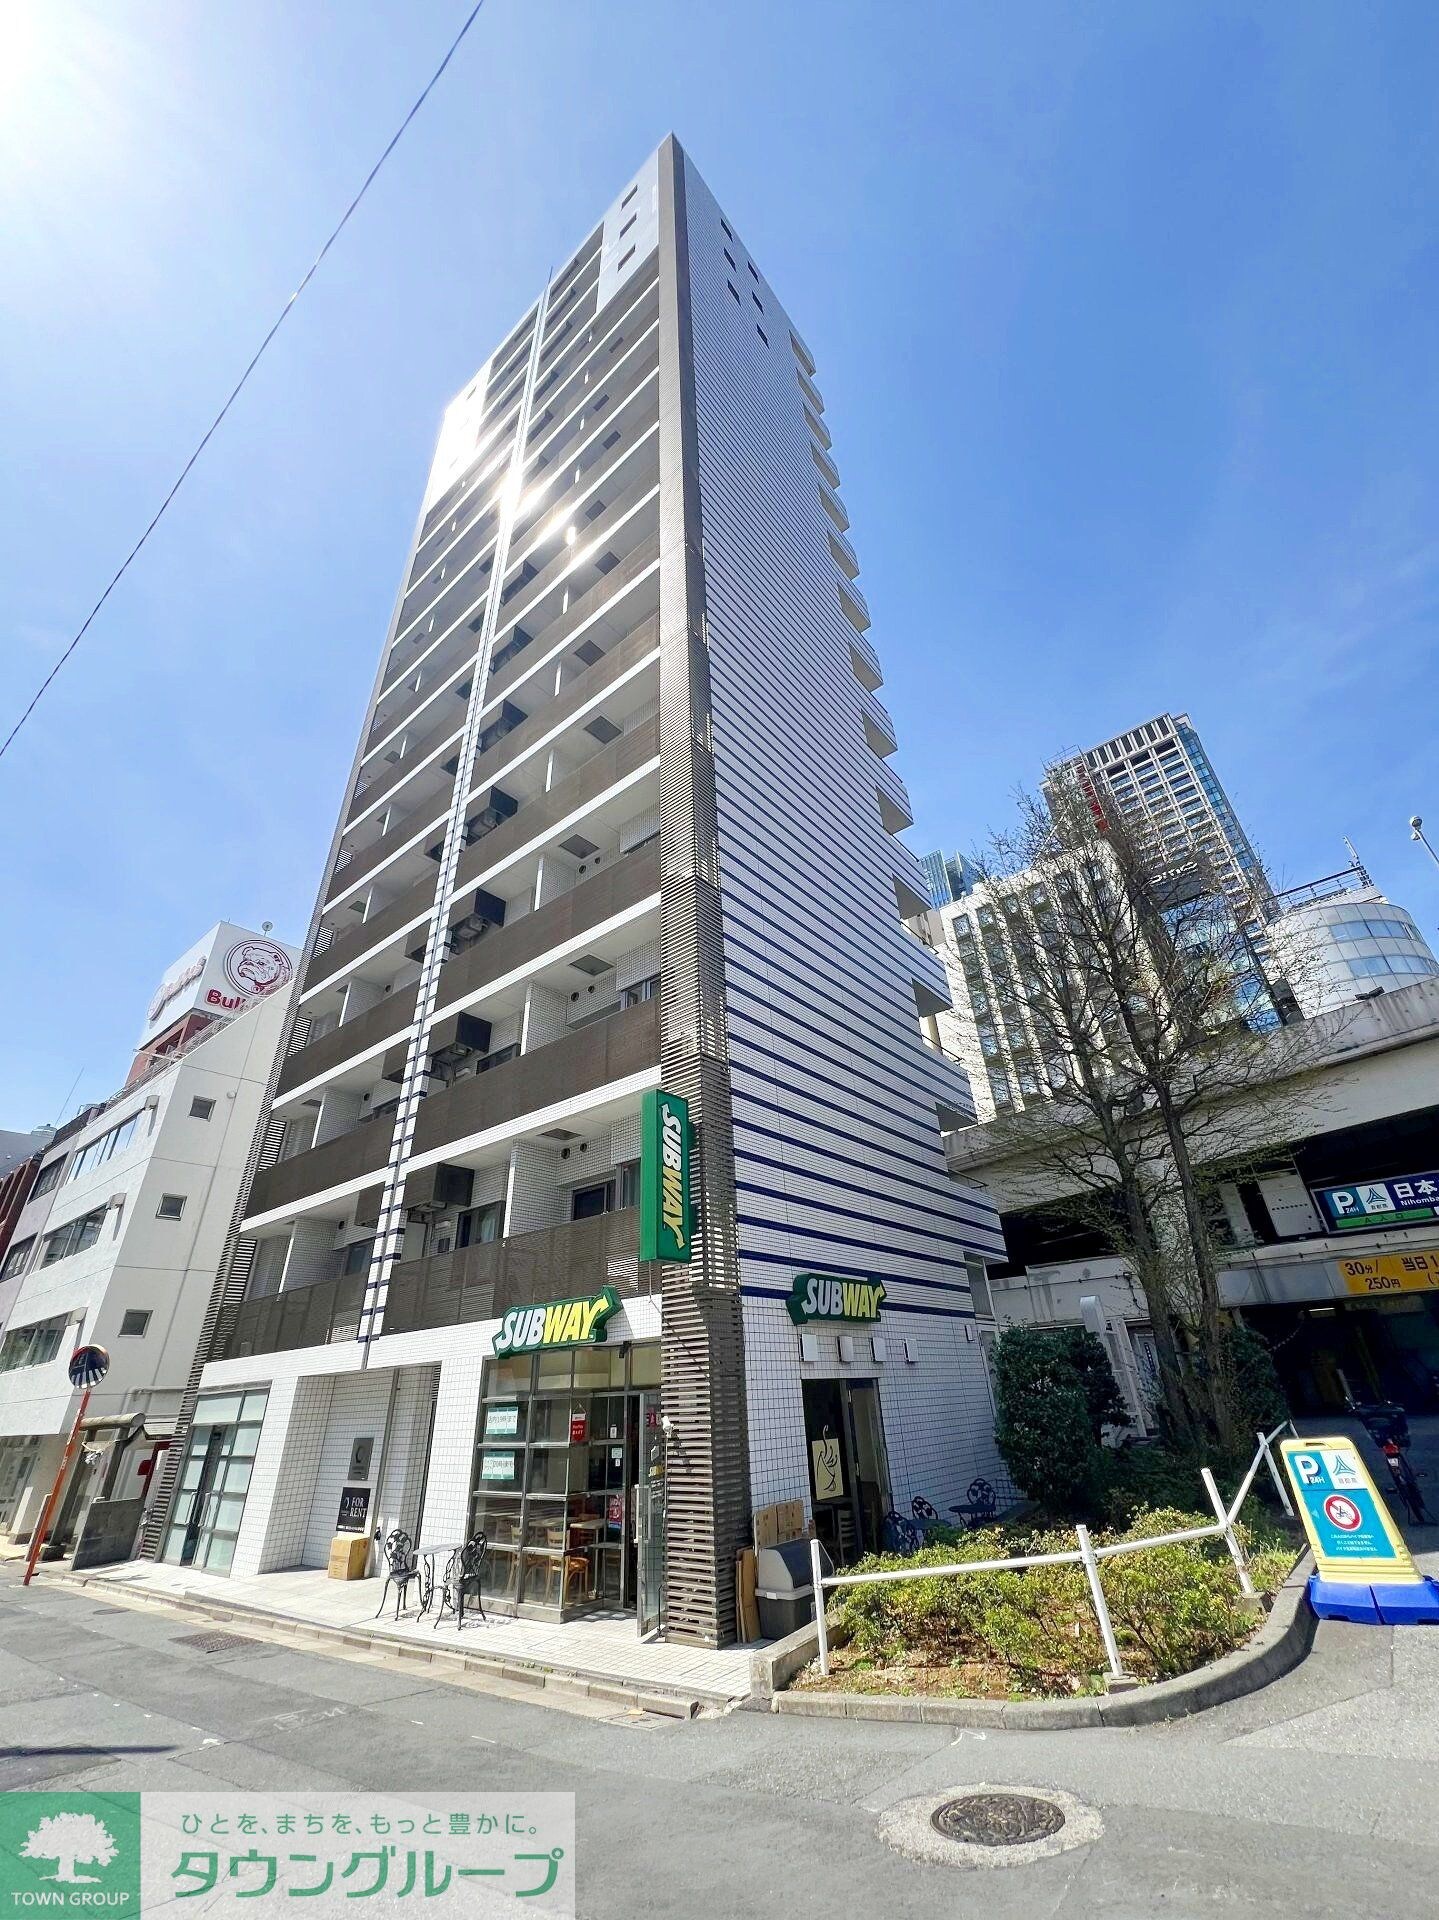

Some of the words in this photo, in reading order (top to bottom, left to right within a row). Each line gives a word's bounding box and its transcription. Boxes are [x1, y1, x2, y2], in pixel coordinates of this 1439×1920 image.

[660, 1103, 686, 1249] SUBWAY
[1331, 1191, 1355, 1215] P
[1345, 1206, 1360, 1214] 24H
[1364, 1276, 1401, 1290] 250円
[801, 1278, 885, 1318] SUBWAY
[495, 1295, 610, 1350] SUBWAY
[1294, 1454, 1320, 1484] P
[1310, 1476, 1326, 1484] 24H
[351, 1497, 365, 1508] FOR
[349, 1507, 368, 1518] RENT
